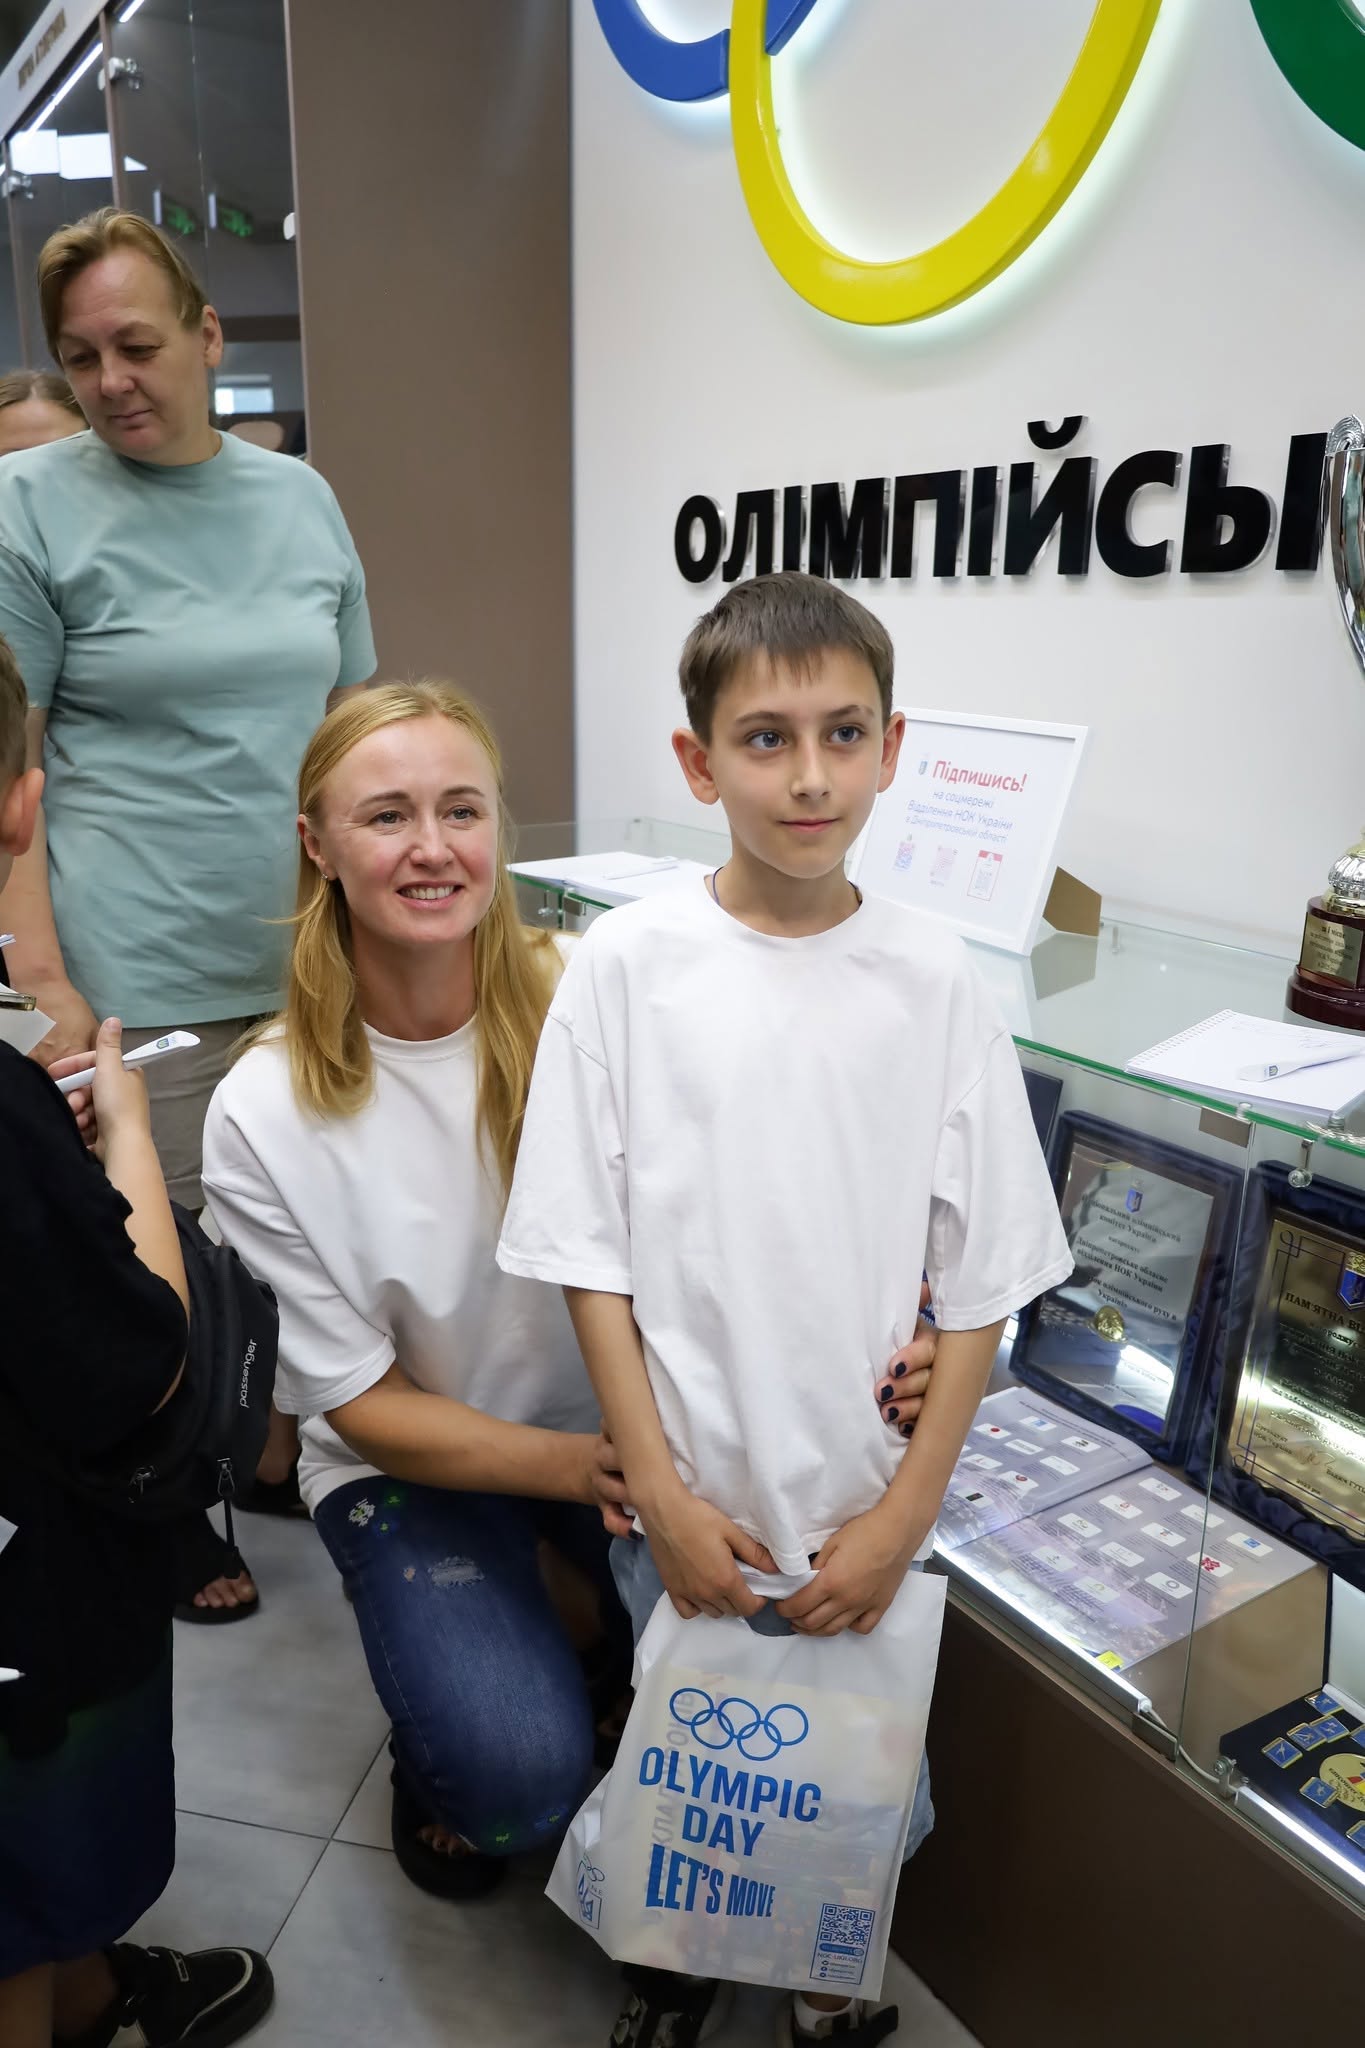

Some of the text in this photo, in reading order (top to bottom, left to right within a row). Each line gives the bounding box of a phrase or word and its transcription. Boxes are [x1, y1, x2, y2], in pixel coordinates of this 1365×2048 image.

[932, 760, 1027, 792] Підпишись!
[907, 800, 1013, 831] Відділення НОК України
[945, 792, 994, 808] соцмережі
[1114, 1263, 1133, 1279] НОК
[1153, 1304, 1171, 1319] руху
[1285, 1291, 1345, 1326] ПАМ'ЯТНА
[240, 1338, 257, 1408] passenger
[638, 1746, 822, 1823] OLYMPIC
[682, 1803, 765, 1857] DAY
[645, 1843, 776, 1918] LET'S MOVE
